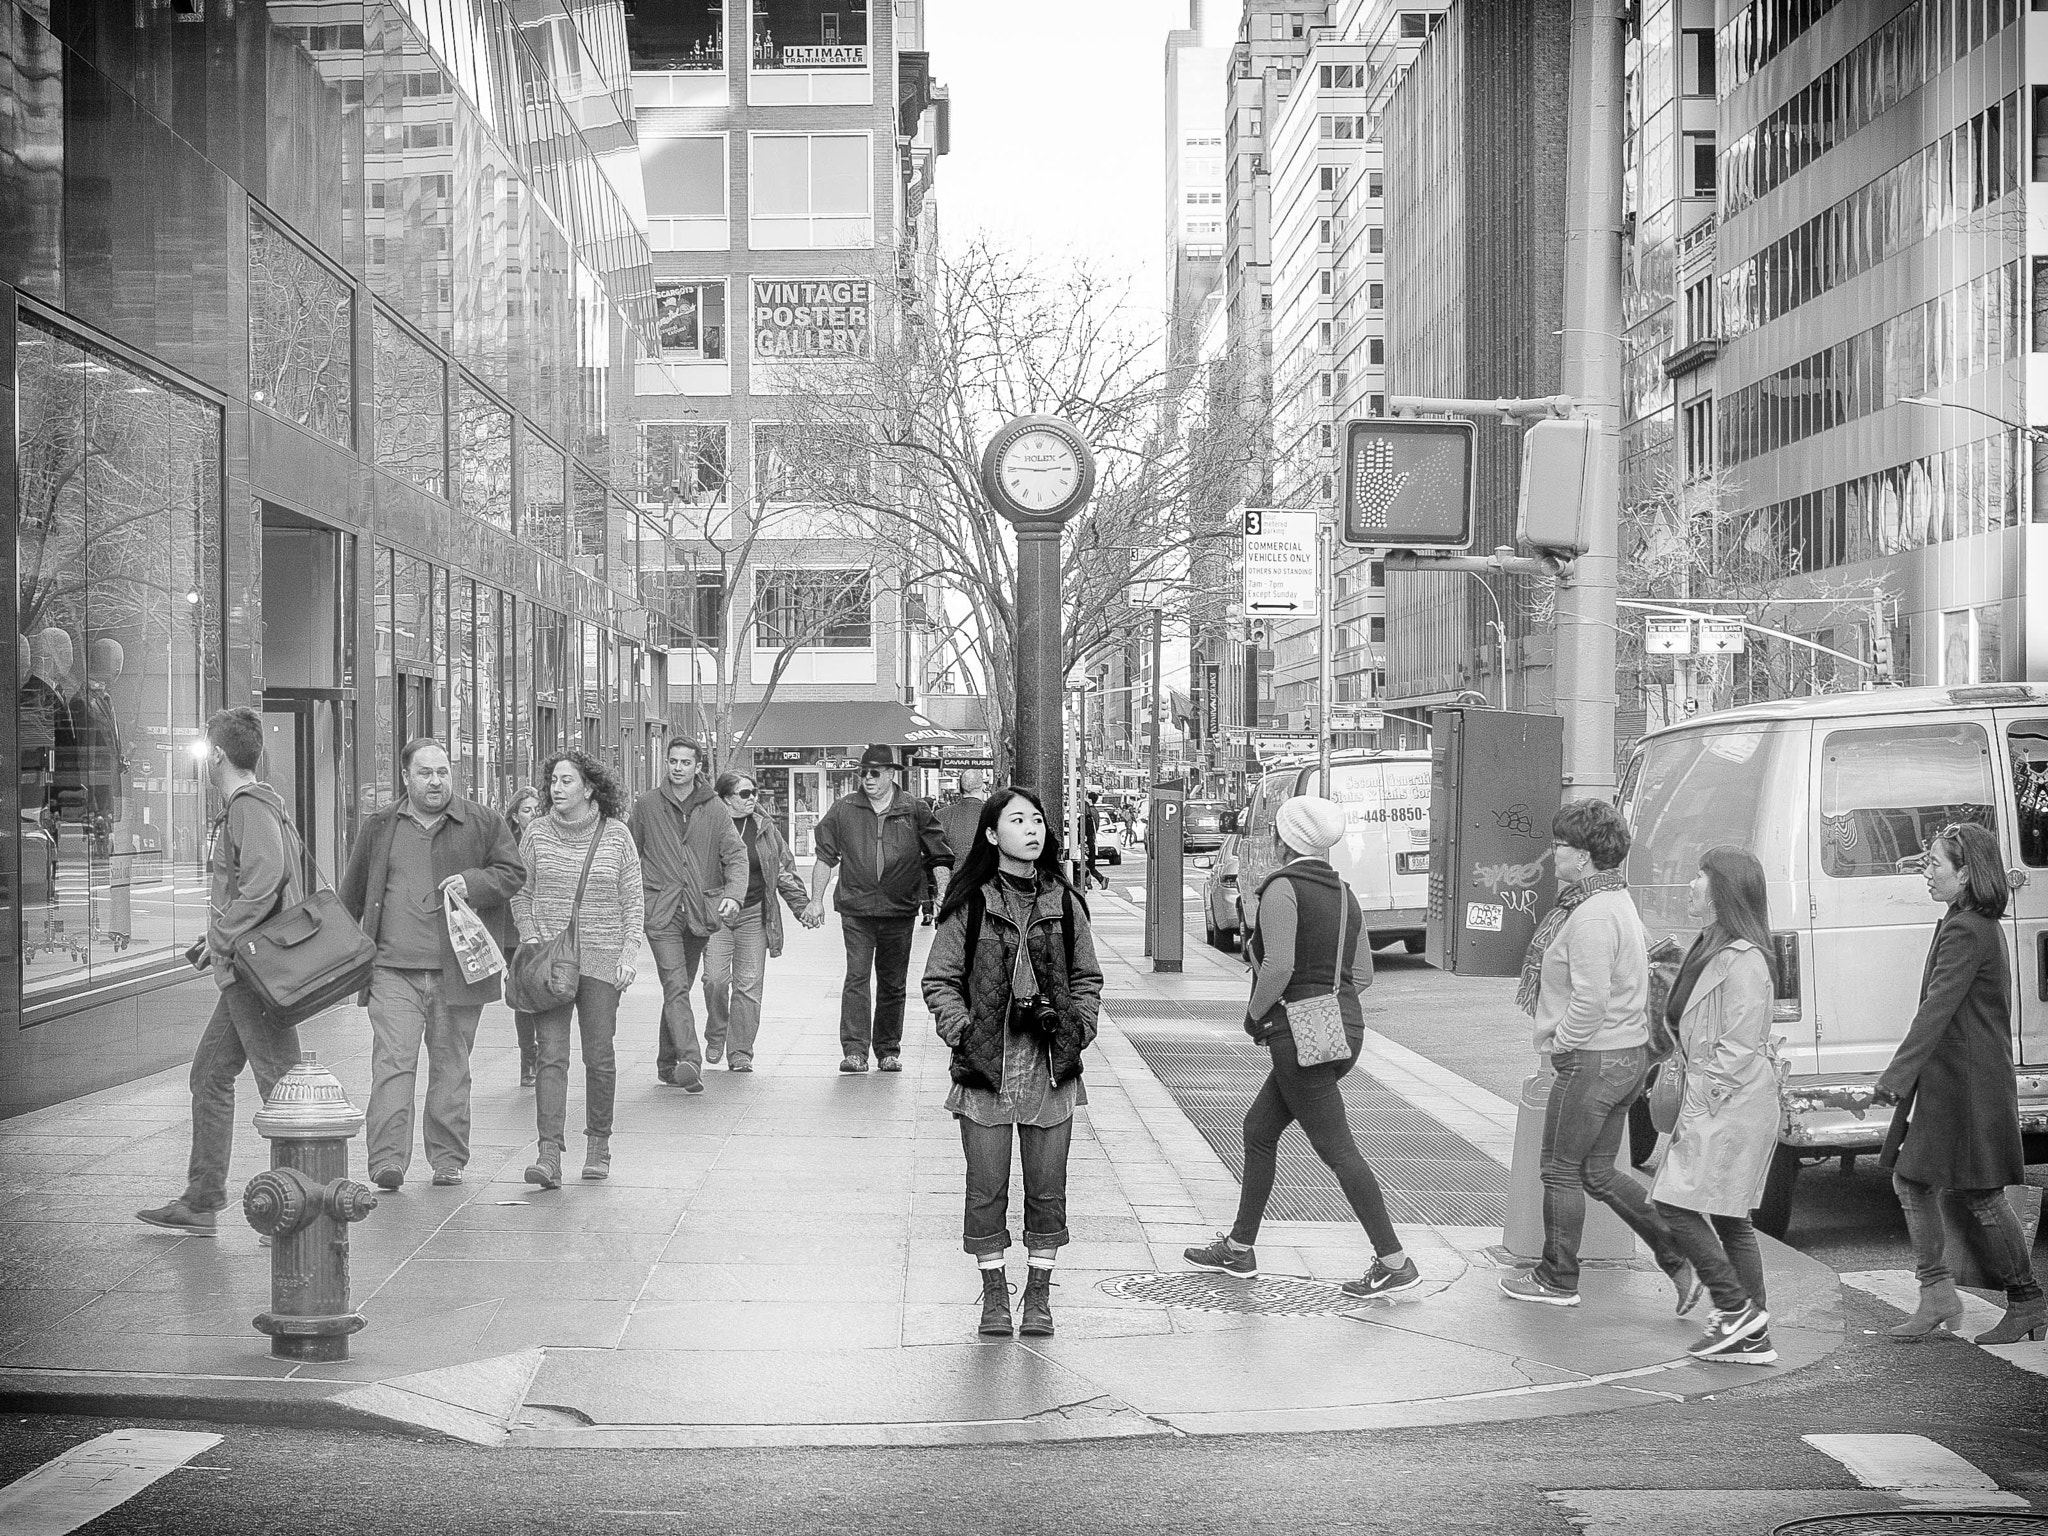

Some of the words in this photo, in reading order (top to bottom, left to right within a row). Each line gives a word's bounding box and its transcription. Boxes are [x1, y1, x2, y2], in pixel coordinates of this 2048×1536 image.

[785, 48, 863, 57] ULTIMATE
[656, 286, 694, 299] SCARGOTS
[757, 283, 867, 304] VINTAGE
[757, 306, 866, 326] POSTER
[757, 329, 867, 356] GALLERY
[1247, 512, 1260, 534] 3
[1248, 541, 1302, 551] COMMERCIAL
[1248, 553, 1288, 562] VEHICLES
[1290, 553, 1311, 562] ONLY
[1248, 567, 1272, 575] OTHERS
[1273, 567, 1282, 575] NO
[1248, 580, 1263, 588] 7am
[1269, 580, 1284, 589] 7pm
[1248, 590, 1271, 599] Except
[1273, 590, 1298, 599] Sunday
[783, 751, 800, 760] OPEN
[1165, 803, 1177, 820] P
